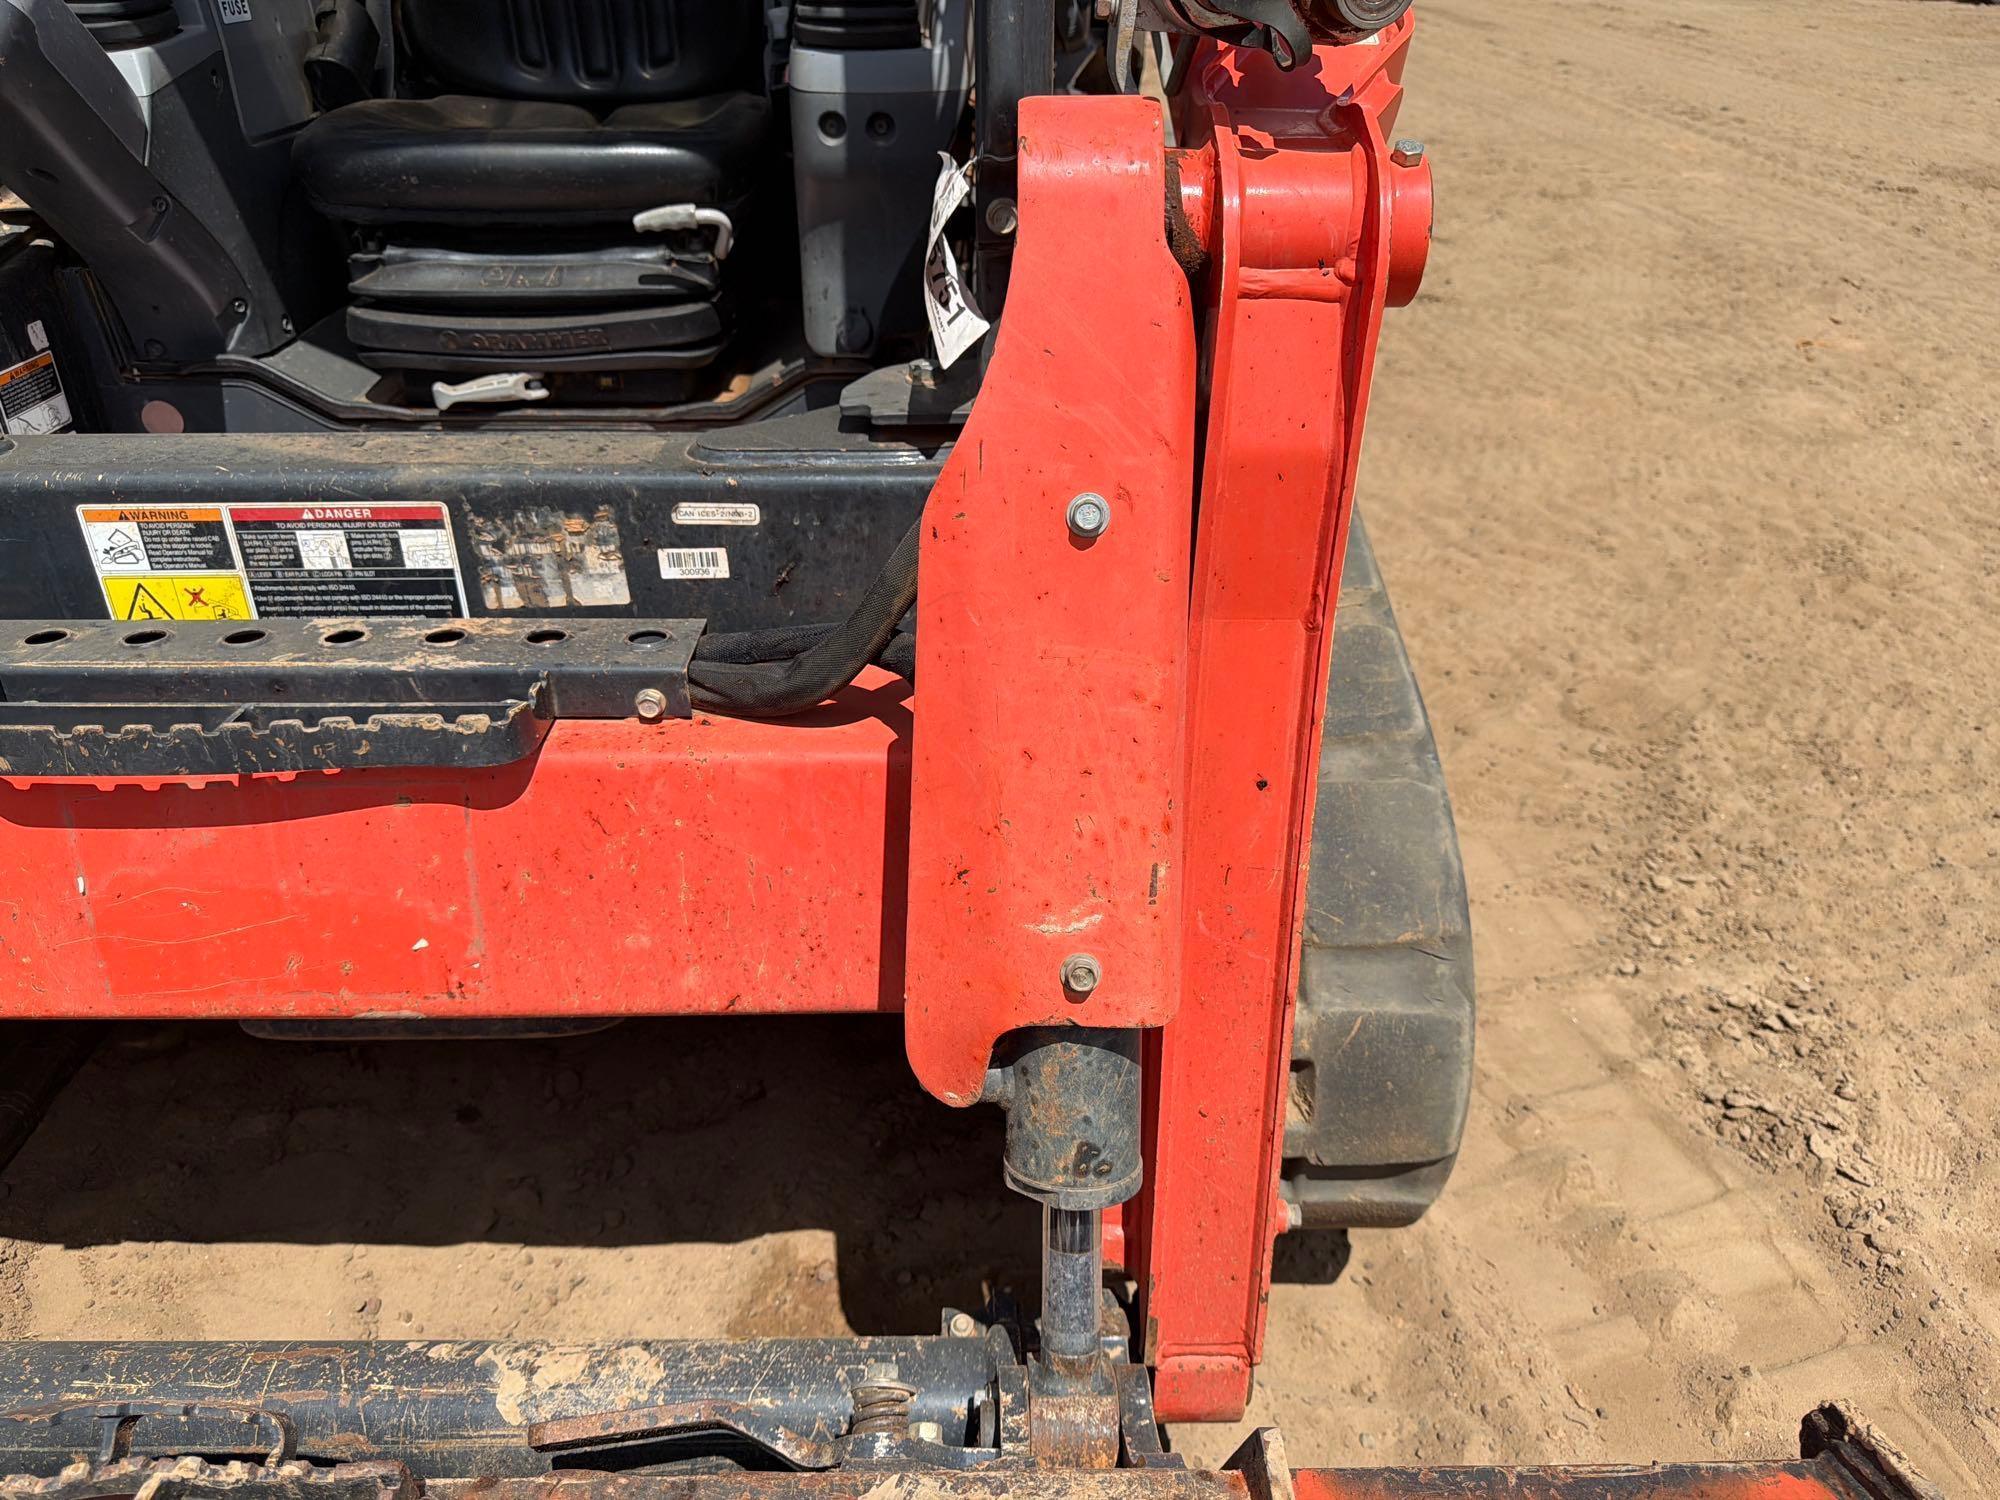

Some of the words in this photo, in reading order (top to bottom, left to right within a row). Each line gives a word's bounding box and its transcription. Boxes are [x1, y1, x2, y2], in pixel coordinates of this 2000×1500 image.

[221, 0, 248, 16] FUSE
[129, 510, 189, 521] WARNING
[314, 508, 372, 519] DANGER
[140, 522, 148, 530] TO
[680, 568, 711, 576] 300936
[403, 594, 426, 602] improper
[426, 594, 454, 602] positioning
